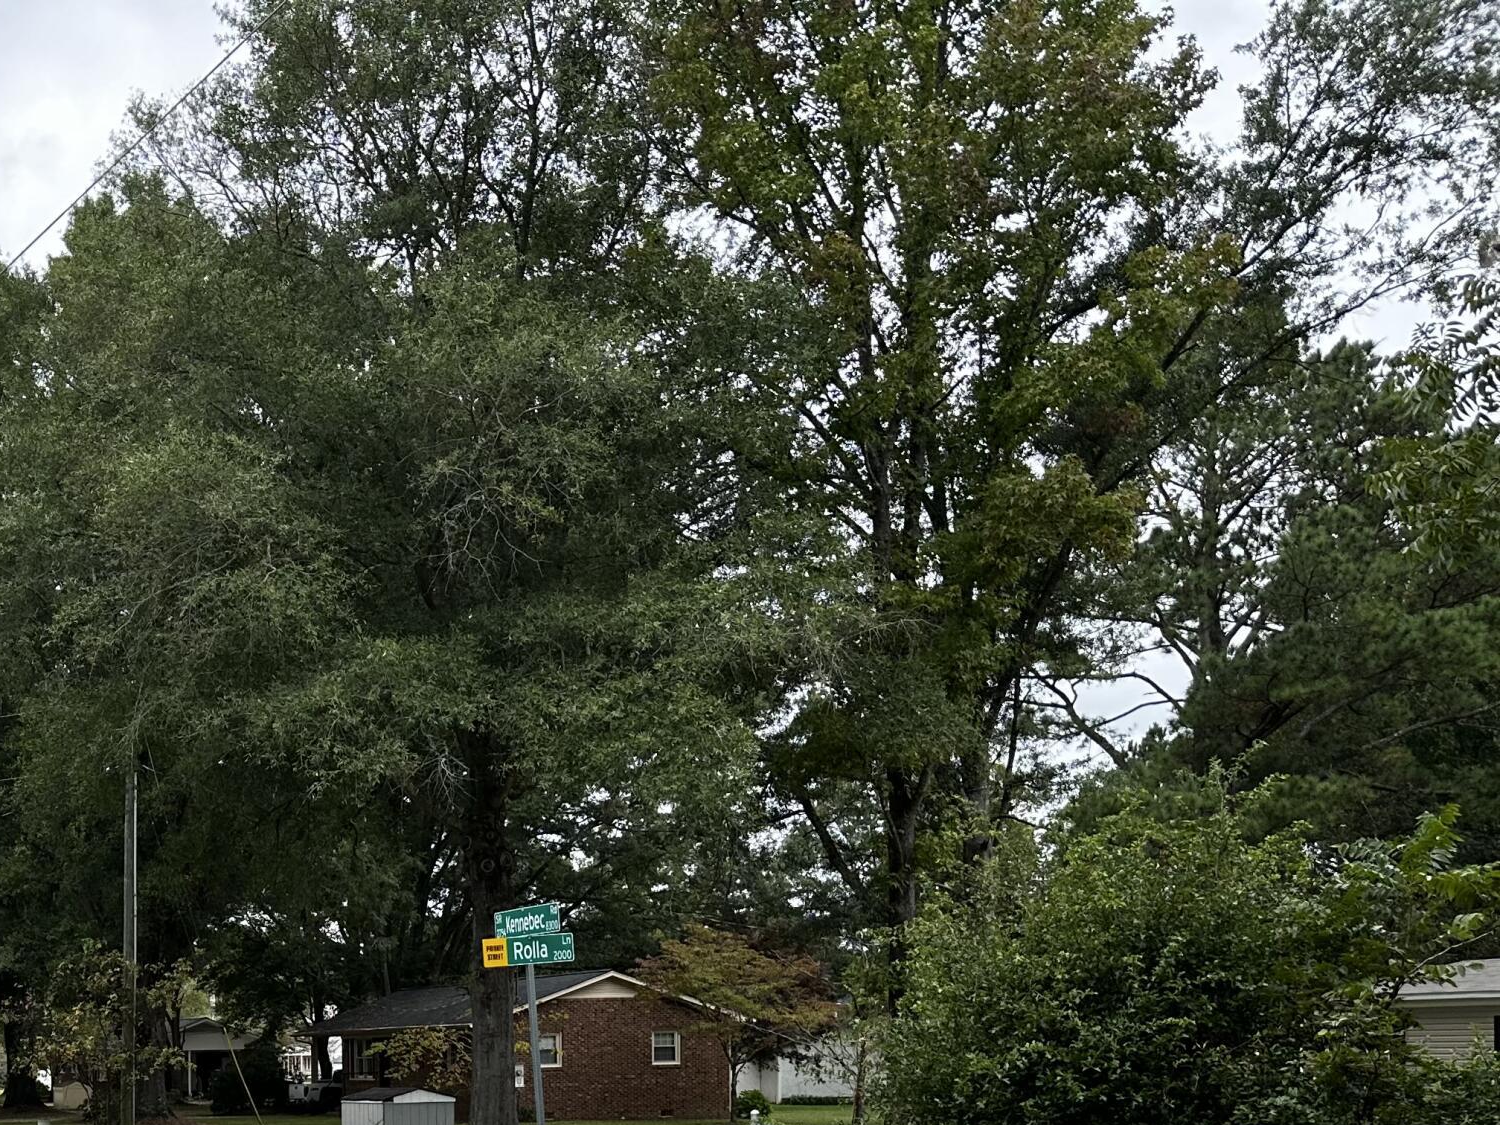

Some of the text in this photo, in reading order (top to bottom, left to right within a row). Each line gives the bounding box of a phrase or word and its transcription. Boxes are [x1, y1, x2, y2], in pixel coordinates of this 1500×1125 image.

[496, 914, 502, 924] SR
[506, 905, 558, 934] Kennebec Rd
[513, 936, 571, 961] Rolla Ln
[553, 949, 572, 961] 2000
